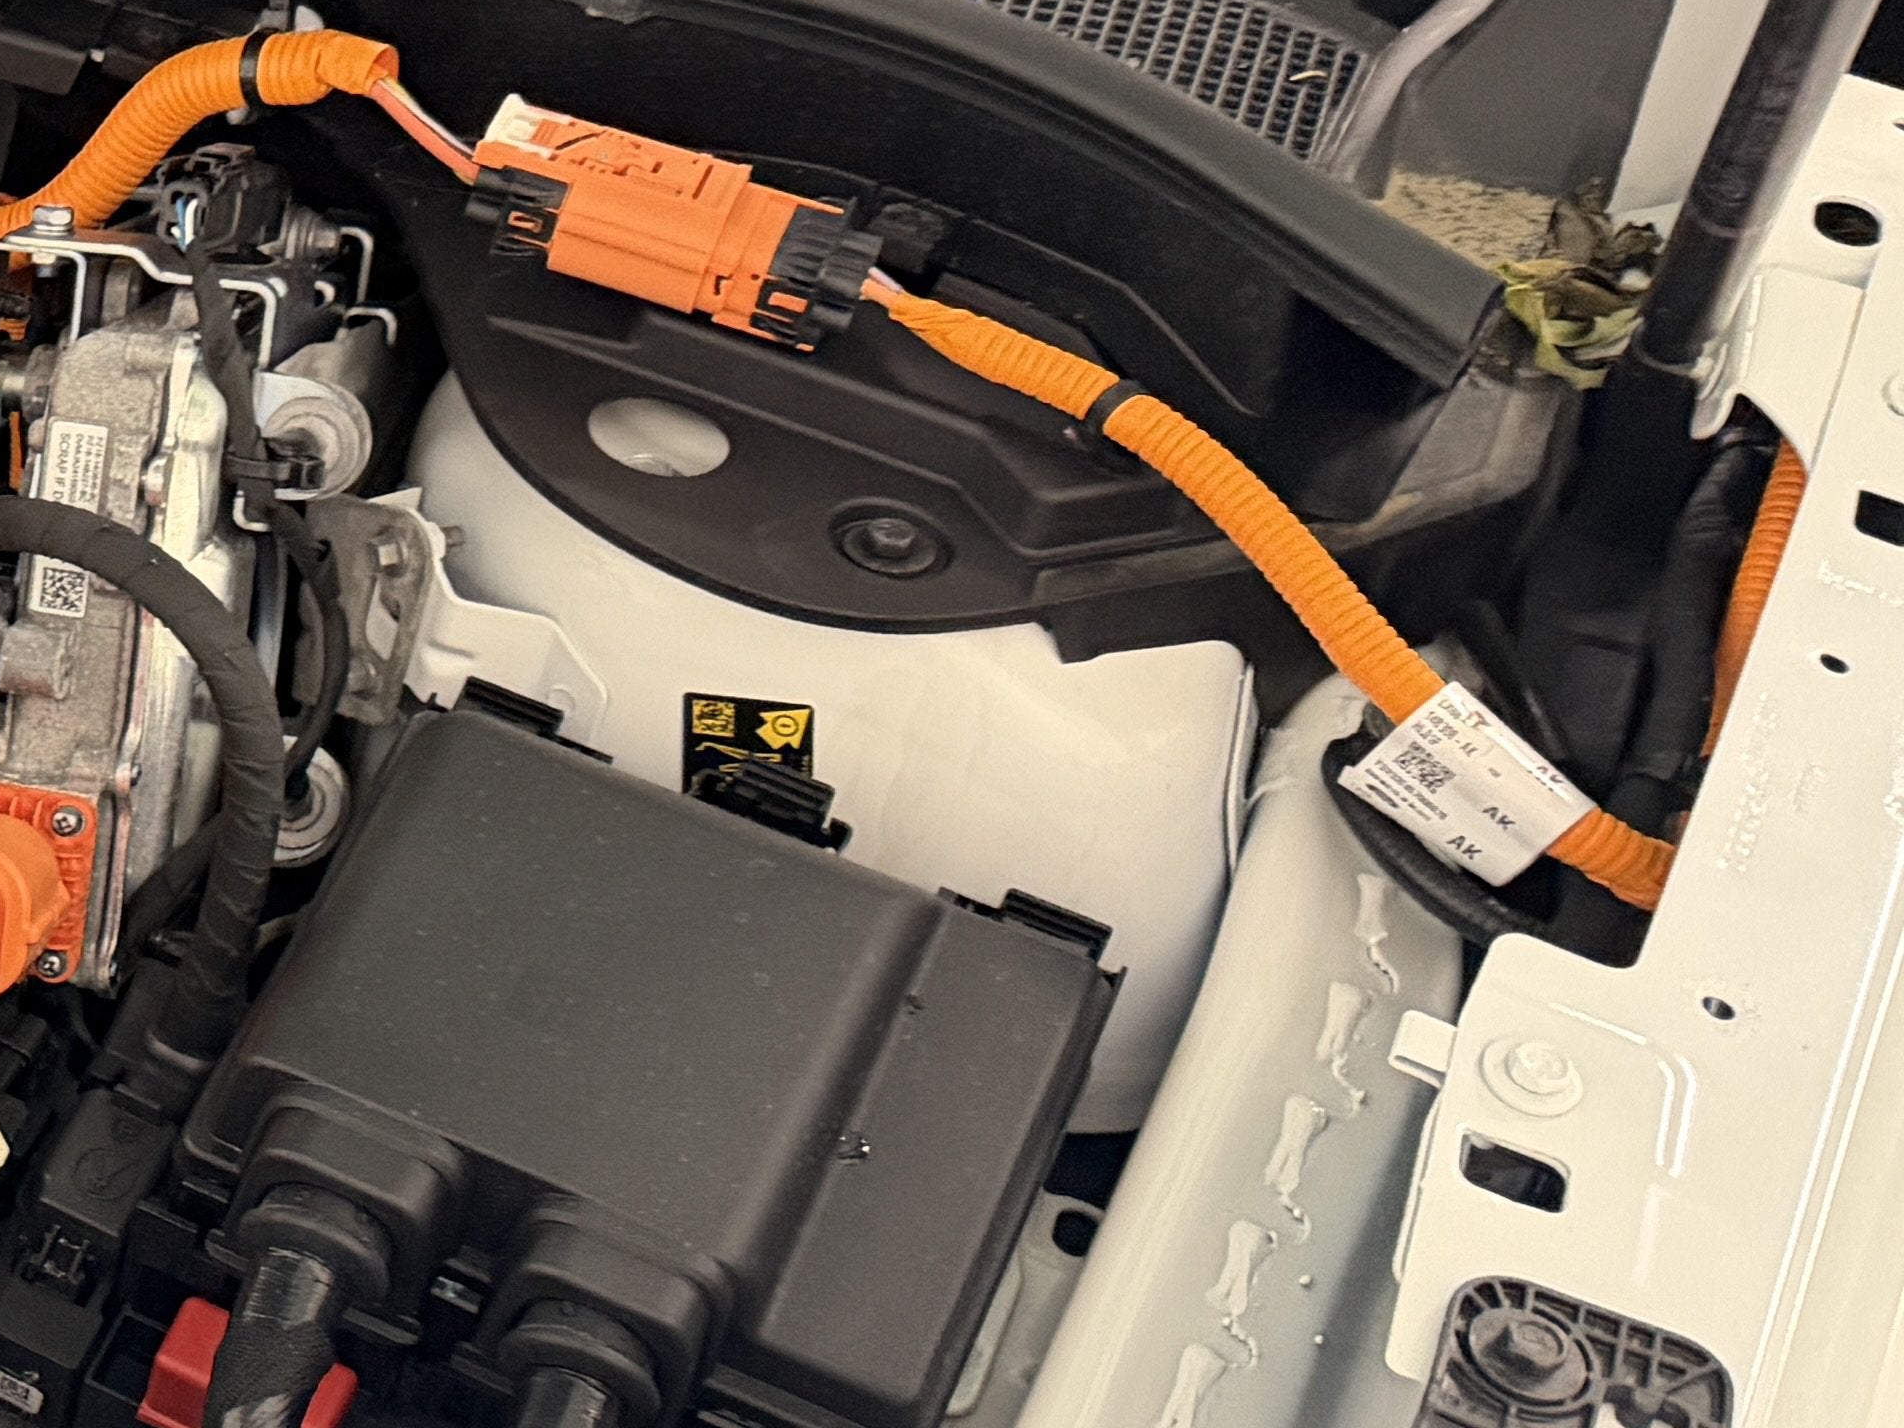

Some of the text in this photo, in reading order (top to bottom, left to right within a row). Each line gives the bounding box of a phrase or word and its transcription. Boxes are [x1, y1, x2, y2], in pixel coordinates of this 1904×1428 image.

[56, 433, 71, 475] SCRAP
[54, 476, 66, 488] IF
[1482, 806, 1516, 832] AK
[1446, 835, 1483, 860] AK
